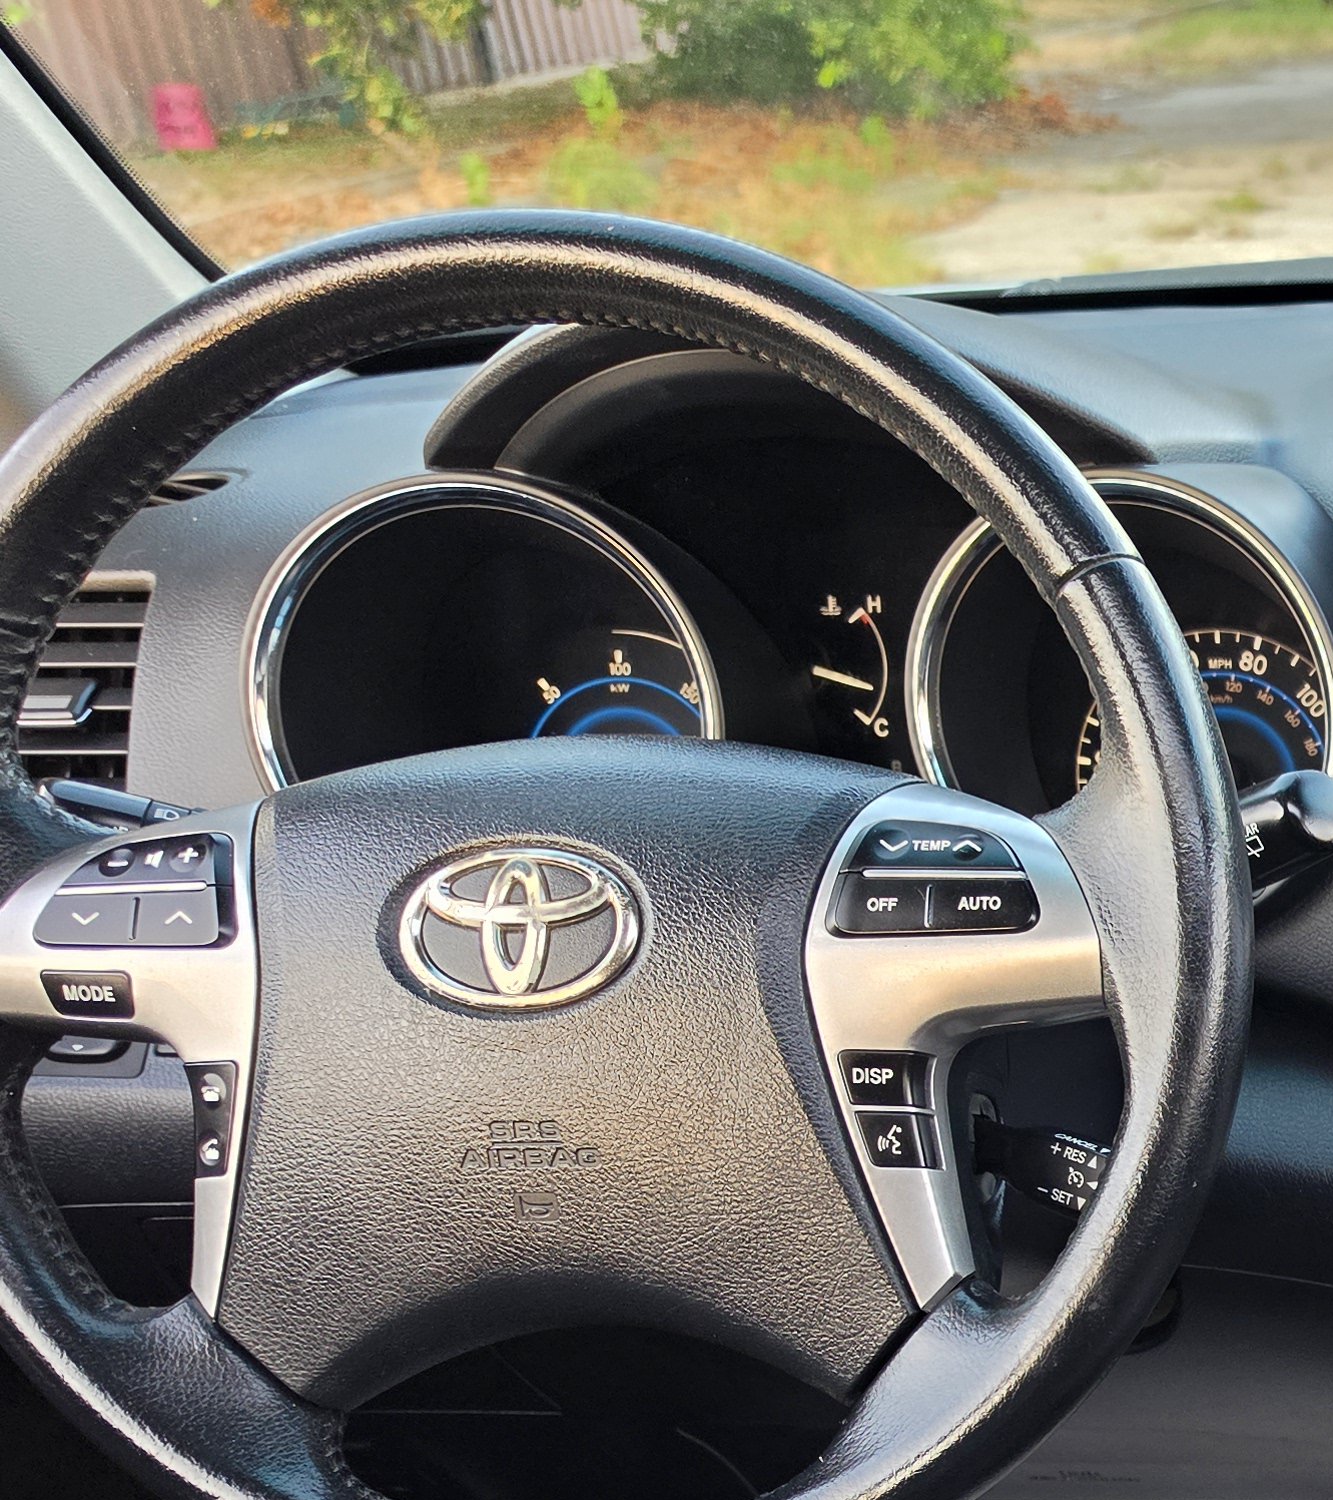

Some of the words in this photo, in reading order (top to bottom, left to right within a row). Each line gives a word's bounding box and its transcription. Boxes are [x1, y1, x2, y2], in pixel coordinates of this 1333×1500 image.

[867, 595, 881, 613] H
[609, 662, 631, 676] 100
[1207, 658, 1232, 669] MPH
[1239, 650, 1267, 675] 80
[1225, 681, 1242, 693] 120
[1296, 683, 1326, 718] 100
[873, 717, 889, 737] C
[912, 839, 950, 852] TEMP
[866, 898, 897, 911] OFF
[958, 896, 1001, 911] AUTO
[62, 984, 116, 1003] MODE
[852, 1068, 893, 1084] DISP
[488, 1120, 562, 1142] SRS
[459, 1146, 601, 1170] AIRBAG
[1063, 1146, 1087, 1164] RES
[1050, 1188, 1074, 1206] SET
